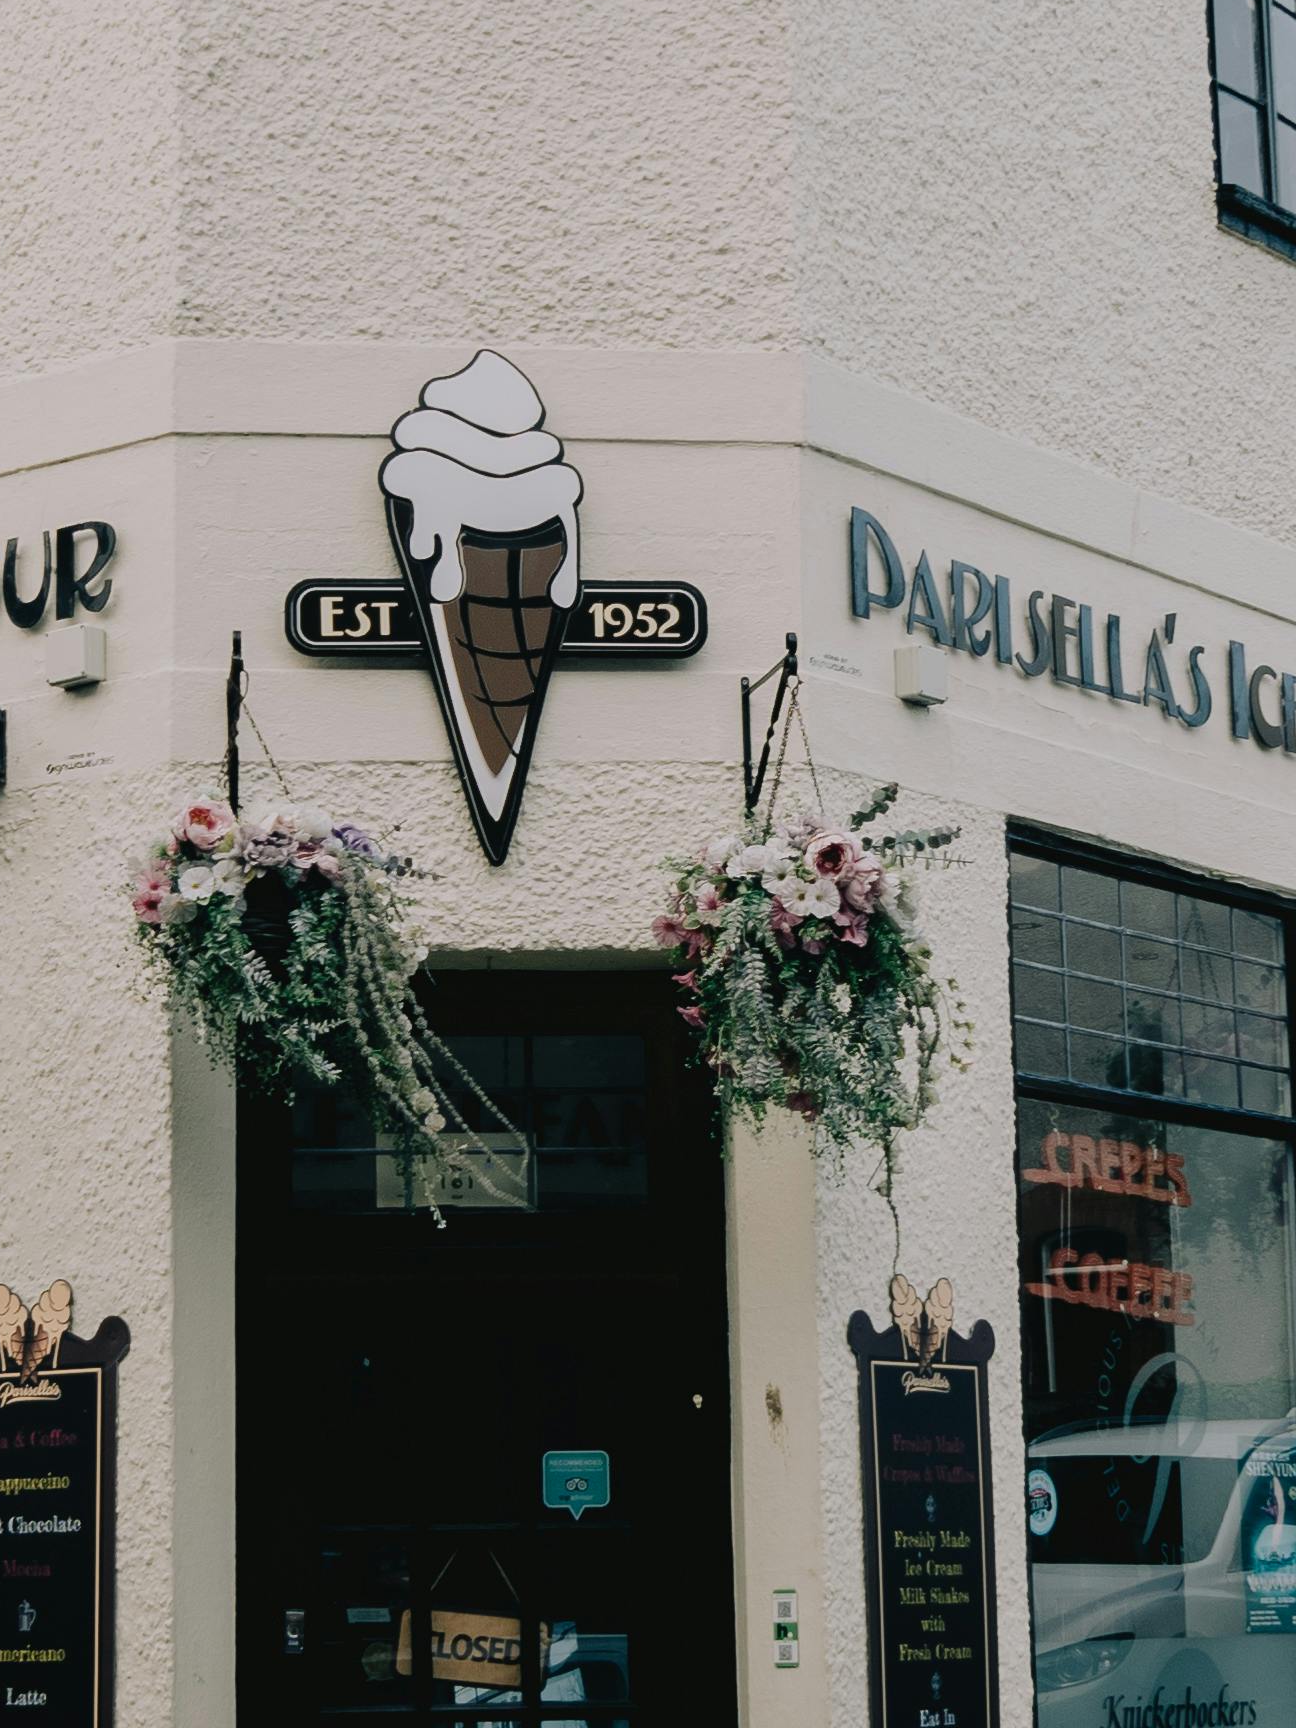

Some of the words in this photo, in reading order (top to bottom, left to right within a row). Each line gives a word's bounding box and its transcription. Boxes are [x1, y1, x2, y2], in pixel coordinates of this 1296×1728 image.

[320, 597, 398, 637] EST
[589, 603, 680, 638] 1952
[851, 506, 1211, 728] PARISELLA'S
[14, 1432, 26, 1449] &
[1246, 1461, 1275, 1477] SHEN
[7, 1514, 81, 1536] Chocolate
[893, 1529, 937, 1553] Freshly
[940, 1530, 971, 1550] Made
[905, 1559, 923, 1577] Ice
[926, 1559, 964, 1577] Cream
[899, 1586, 927, 1606] Milk
[930, 1586, 971, 1605] Shakes
[921, 1614, 946, 1633] with
[899, 1643, 932, 1662] Fresh
[935, 1642, 973, 1662] Cream
[5, 1686, 47, 1708] Latte
[919, 1708, 941, 1728] Eat
[944, 1707, 956, 1727] In
